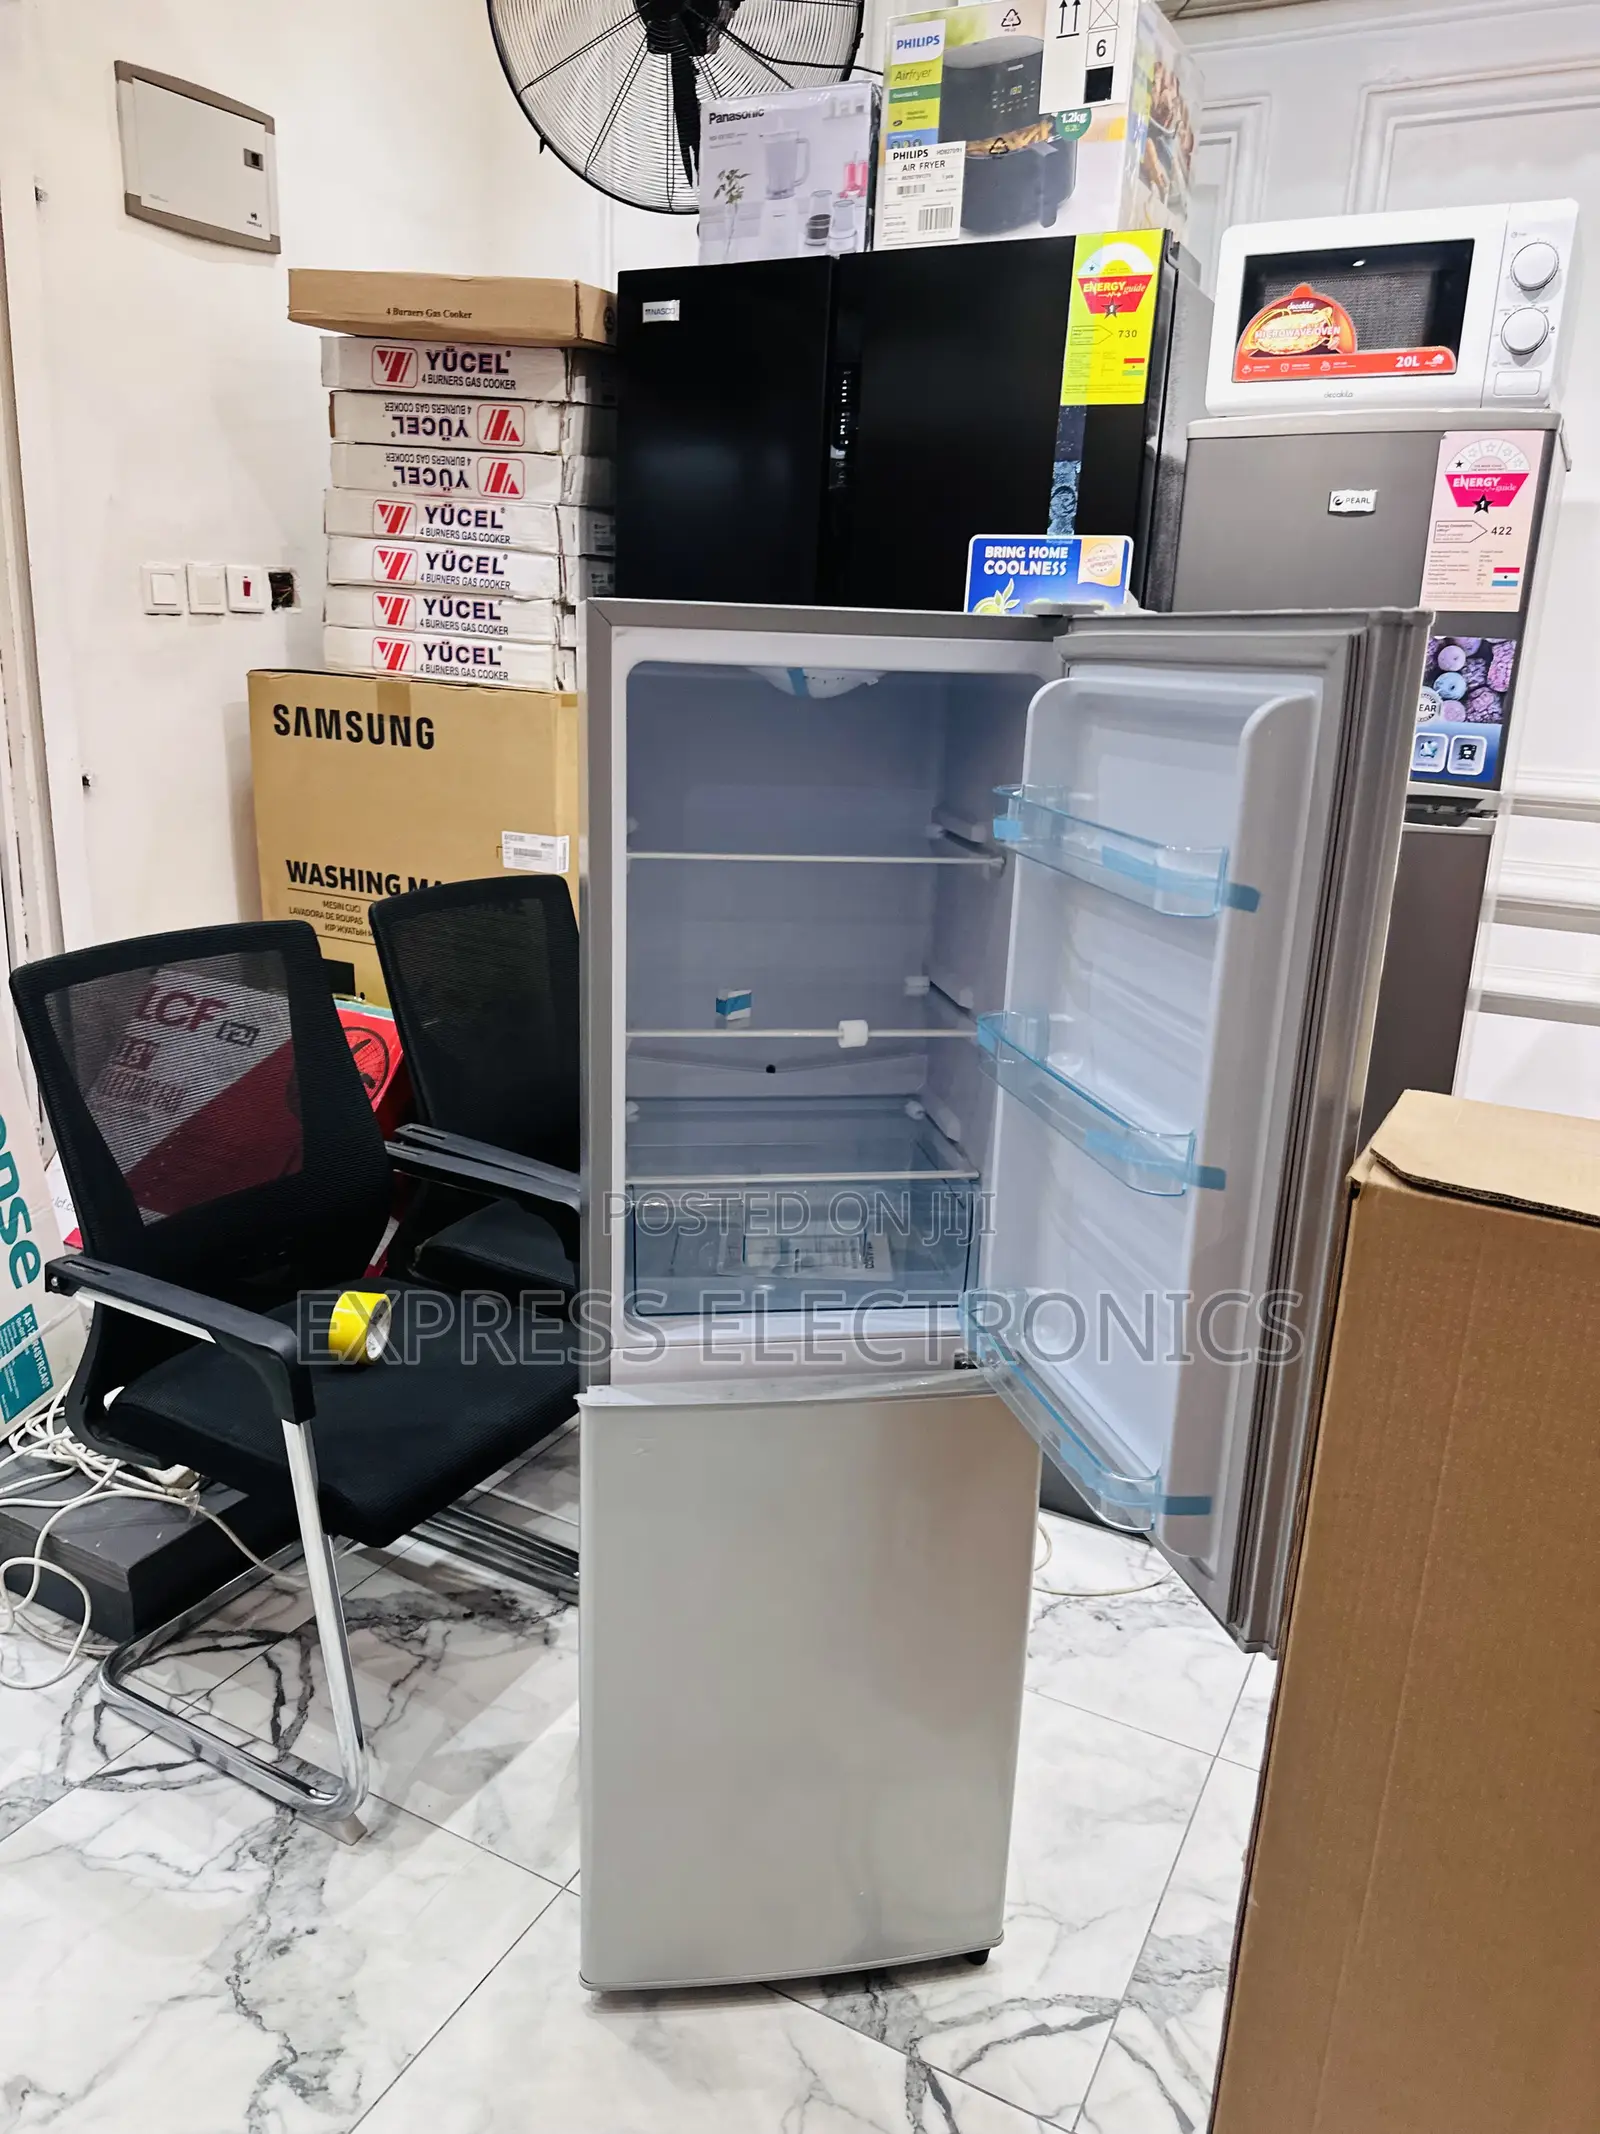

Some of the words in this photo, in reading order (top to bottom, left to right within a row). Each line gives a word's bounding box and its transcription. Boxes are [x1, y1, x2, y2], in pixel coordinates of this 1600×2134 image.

[895, 34, 941, 50] PHILIPS
[1096, 39, 1107, 58] 6
[894, 66, 932, 82] Airfryer
[708, 108, 765, 125] Panasonic
[893, 149, 929, 160] PHILIPS
[902, 163, 916, 172] AIR
[919, 160, 946, 169] FRYER
[1083, 280, 1127, 296] ENERGY
[1123, 283, 1146, 295] guide
[385, 307, 391, 315] 4
[392, 308, 424, 317] Burners
[425, 309, 441, 318] Gas
[443, 310, 472, 319] Cooker
[1118, 329, 1138, 338] 730
[1255, 327, 1312, 338] MICROWAVE
[1314, 326, 1341, 336] OVEN
[425, 345, 510, 374] YÜCEL
[1395, 355, 1420, 368] 20L
[421, 374, 427, 384] 4
[427, 375, 464, 386] BURNERS
[465, 376, 481, 388] GAS
[483, 379, 516, 391] COOKER
[384, 401, 413, 412] COOKER
[413, 402, 430, 413] GAS
[431, 403, 466, 415] BURNERS
[467, 405, 472, 415] 4
[392, 415, 469, 441] YÜCEL
[385, 452, 414, 463] COOKER
[415, 453, 430, 464] GAS
[431, 454, 465, 465] BURNERS
[466, 456, 471, 465] 4
[393, 465, 469, 491] YÜCEL
[1453, 475, 1501, 490] ENERGY
[1495, 483, 1517, 492] guide
[424, 504, 504, 529] YÜCEL
[420, 527, 425, 536] 4
[425, 527, 460, 539] BURNERS
[461, 530, 477, 541] GAS
[478, 532, 511, 544] COOKER
[1490, 526, 1513, 536] 422
[984, 545, 1026, 559] BRING
[1028, 546, 1069, 559] HOME
[425, 550, 505, 575] YÜCEL
[983, 560, 1068, 577] COOLNESS
[420, 573, 426, 582] 4
[426, 573, 460, 585] BURNERS
[461, 576, 478, 587] GAS
[478, 578, 511, 590] COOKER
[423, 596, 502, 620] YÜCEL
[420, 618, 425, 627] 4
[425, 619, 459, 630] BURNERS
[461, 621, 477, 633] GAS
[477, 623, 509, 635] COOKER
[423, 641, 502, 666] YÜCEL
[420, 664, 425, 672] 4
[425, 664, 459, 676] BURNERS
[460, 667, 477, 678] GAS
[477, 669, 509, 680] COOKER
[1418, 703, 1437, 713] EAR
[273, 703, 435, 750] SAMSUNG
[285, 859, 401, 896] WASHING
[322, 900, 344, 911] MESIN
[345, 903, 361, 913] CUCI
[288, 906, 324, 919] LAVADORA
[325, 911, 335, 920] DE
[335, 913, 364, 925] ROUPAS
[134, 983, 229, 1032] LCF
